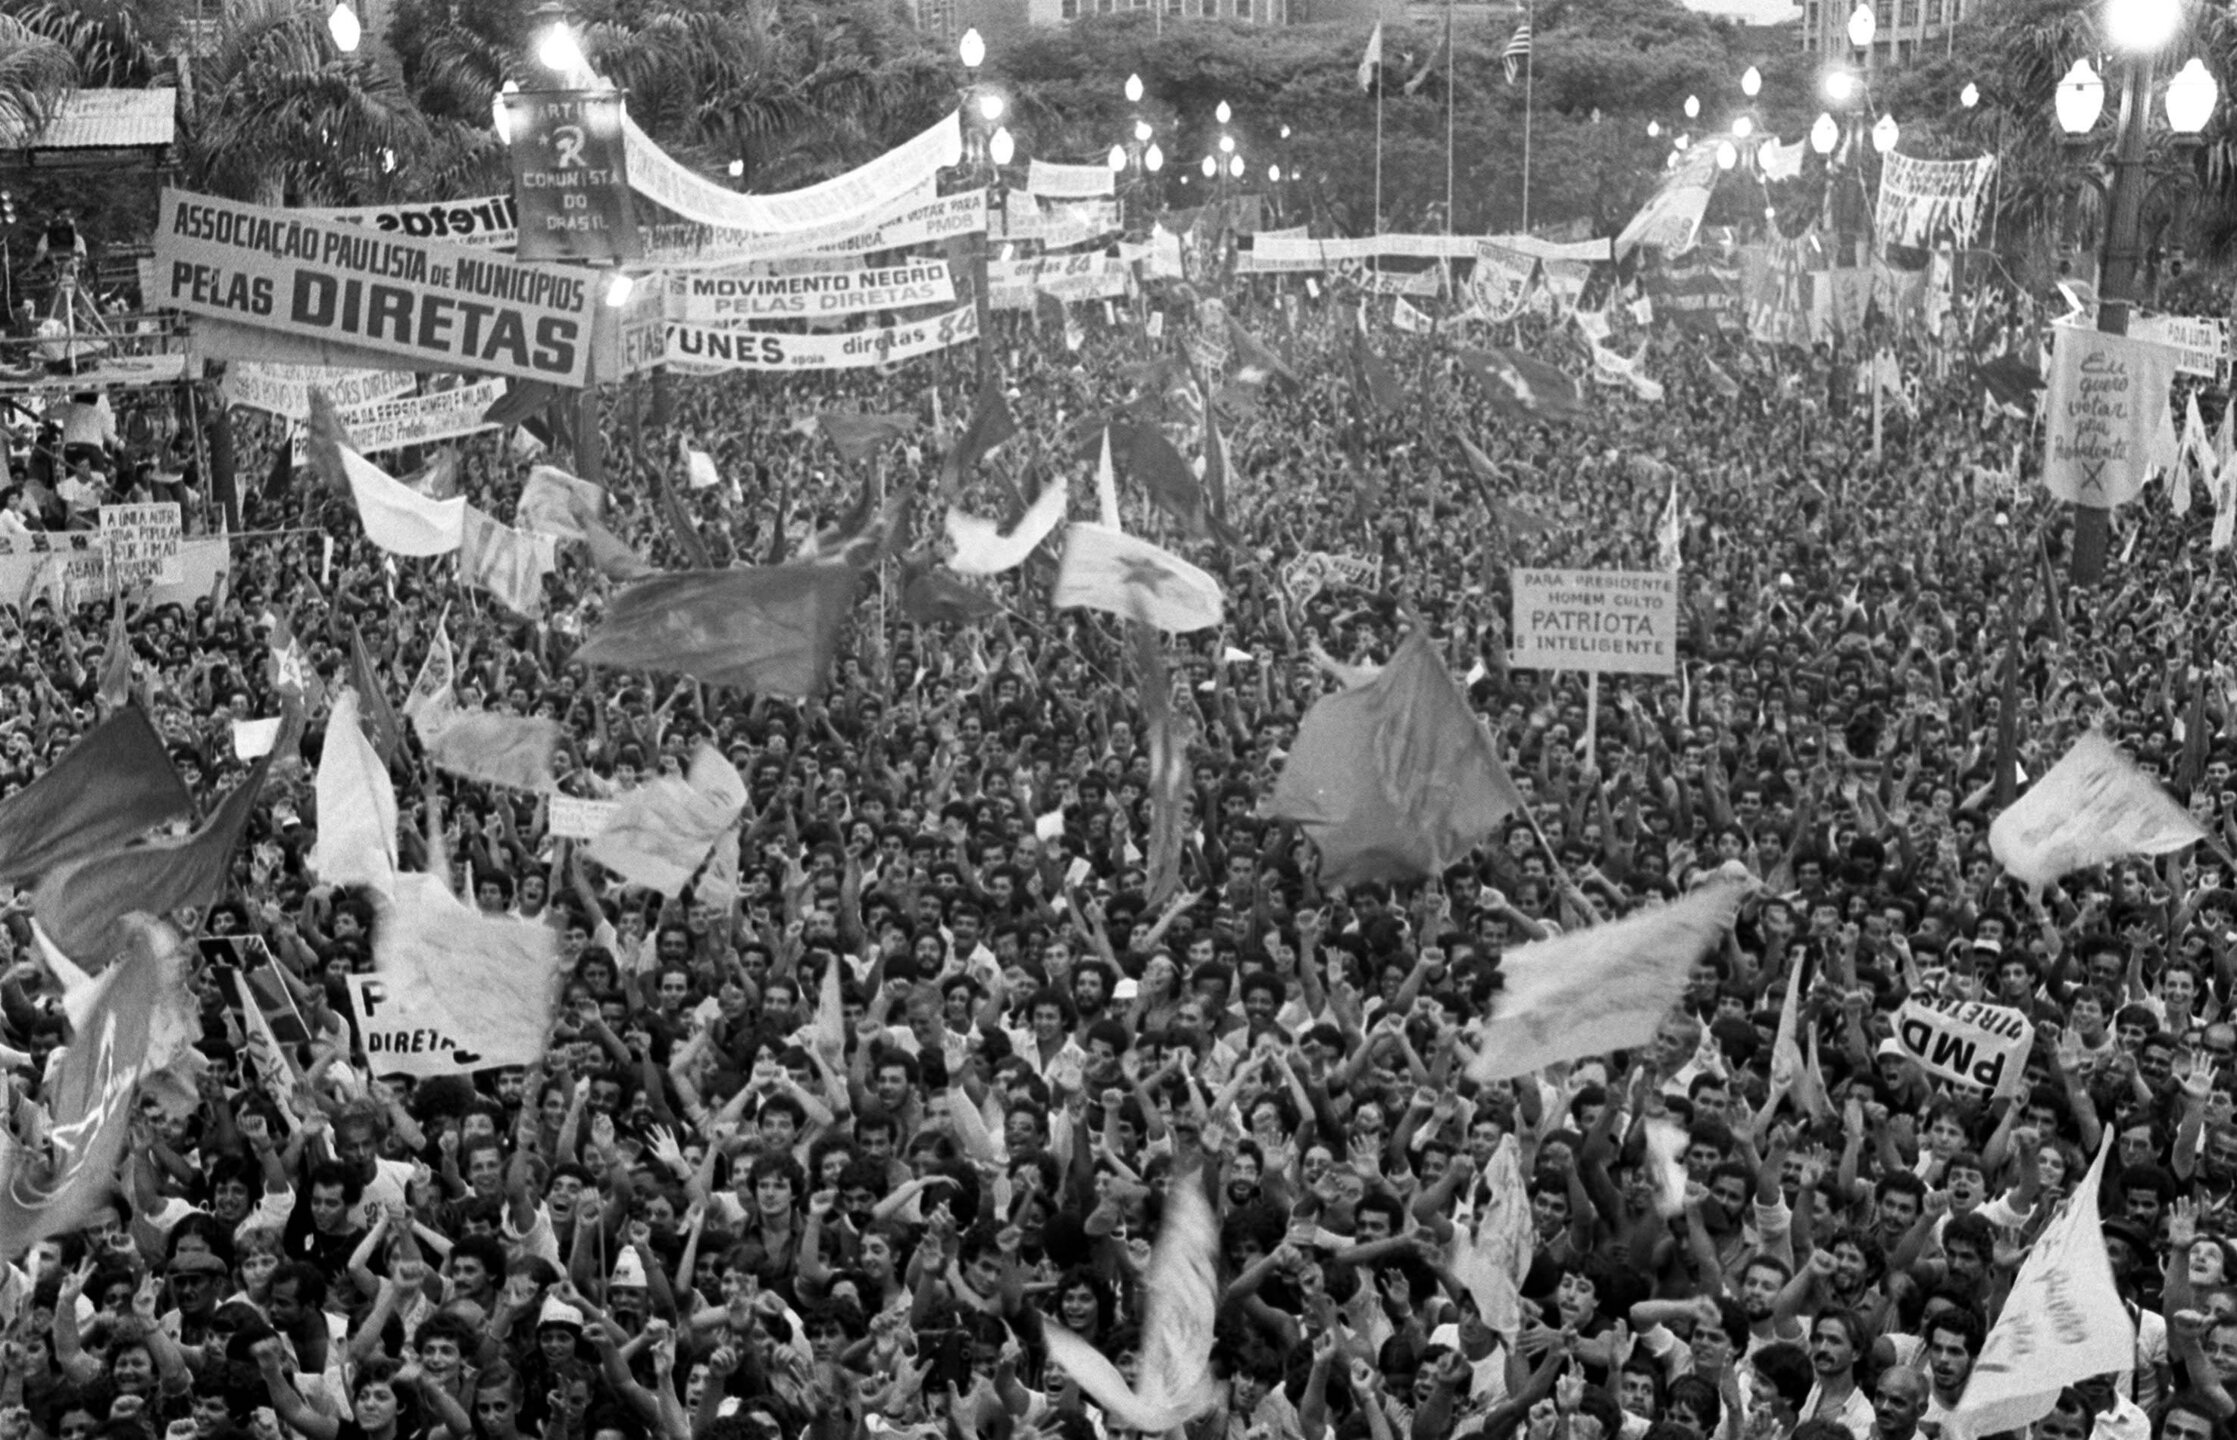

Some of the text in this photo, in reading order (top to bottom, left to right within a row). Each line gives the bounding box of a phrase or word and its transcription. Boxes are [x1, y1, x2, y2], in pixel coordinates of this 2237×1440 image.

[522, 169, 620, 188] COMUNISTA
[563, 194, 588, 210] DO
[173, 202, 320, 262] ASSOCIAÇÃO
[323, 231, 427, 284] PAULISTA
[455, 257, 585, 313] MUNICÍPIOS
[693, 265, 944, 296] MOVIMENTO NEGRO
[715, 284, 935, 314] PELAS DIRETAS
[171, 260, 579, 375] PELAS DIRETAS
[937, 307, 977, 343] 84
[2080, 350, 2126, 375] Eu
[2079, 376, 2129, 399] quero
[2068, 394, 2128, 419] votar
[1524, 573, 1673, 593] PARA PRESIDENTE
[1548, 591, 1664, 610] HOMEM CULTO
[1531, 609, 1655, 637] PATRIOTA
[1516, 635, 1665, 656] E INTELIGENTE
